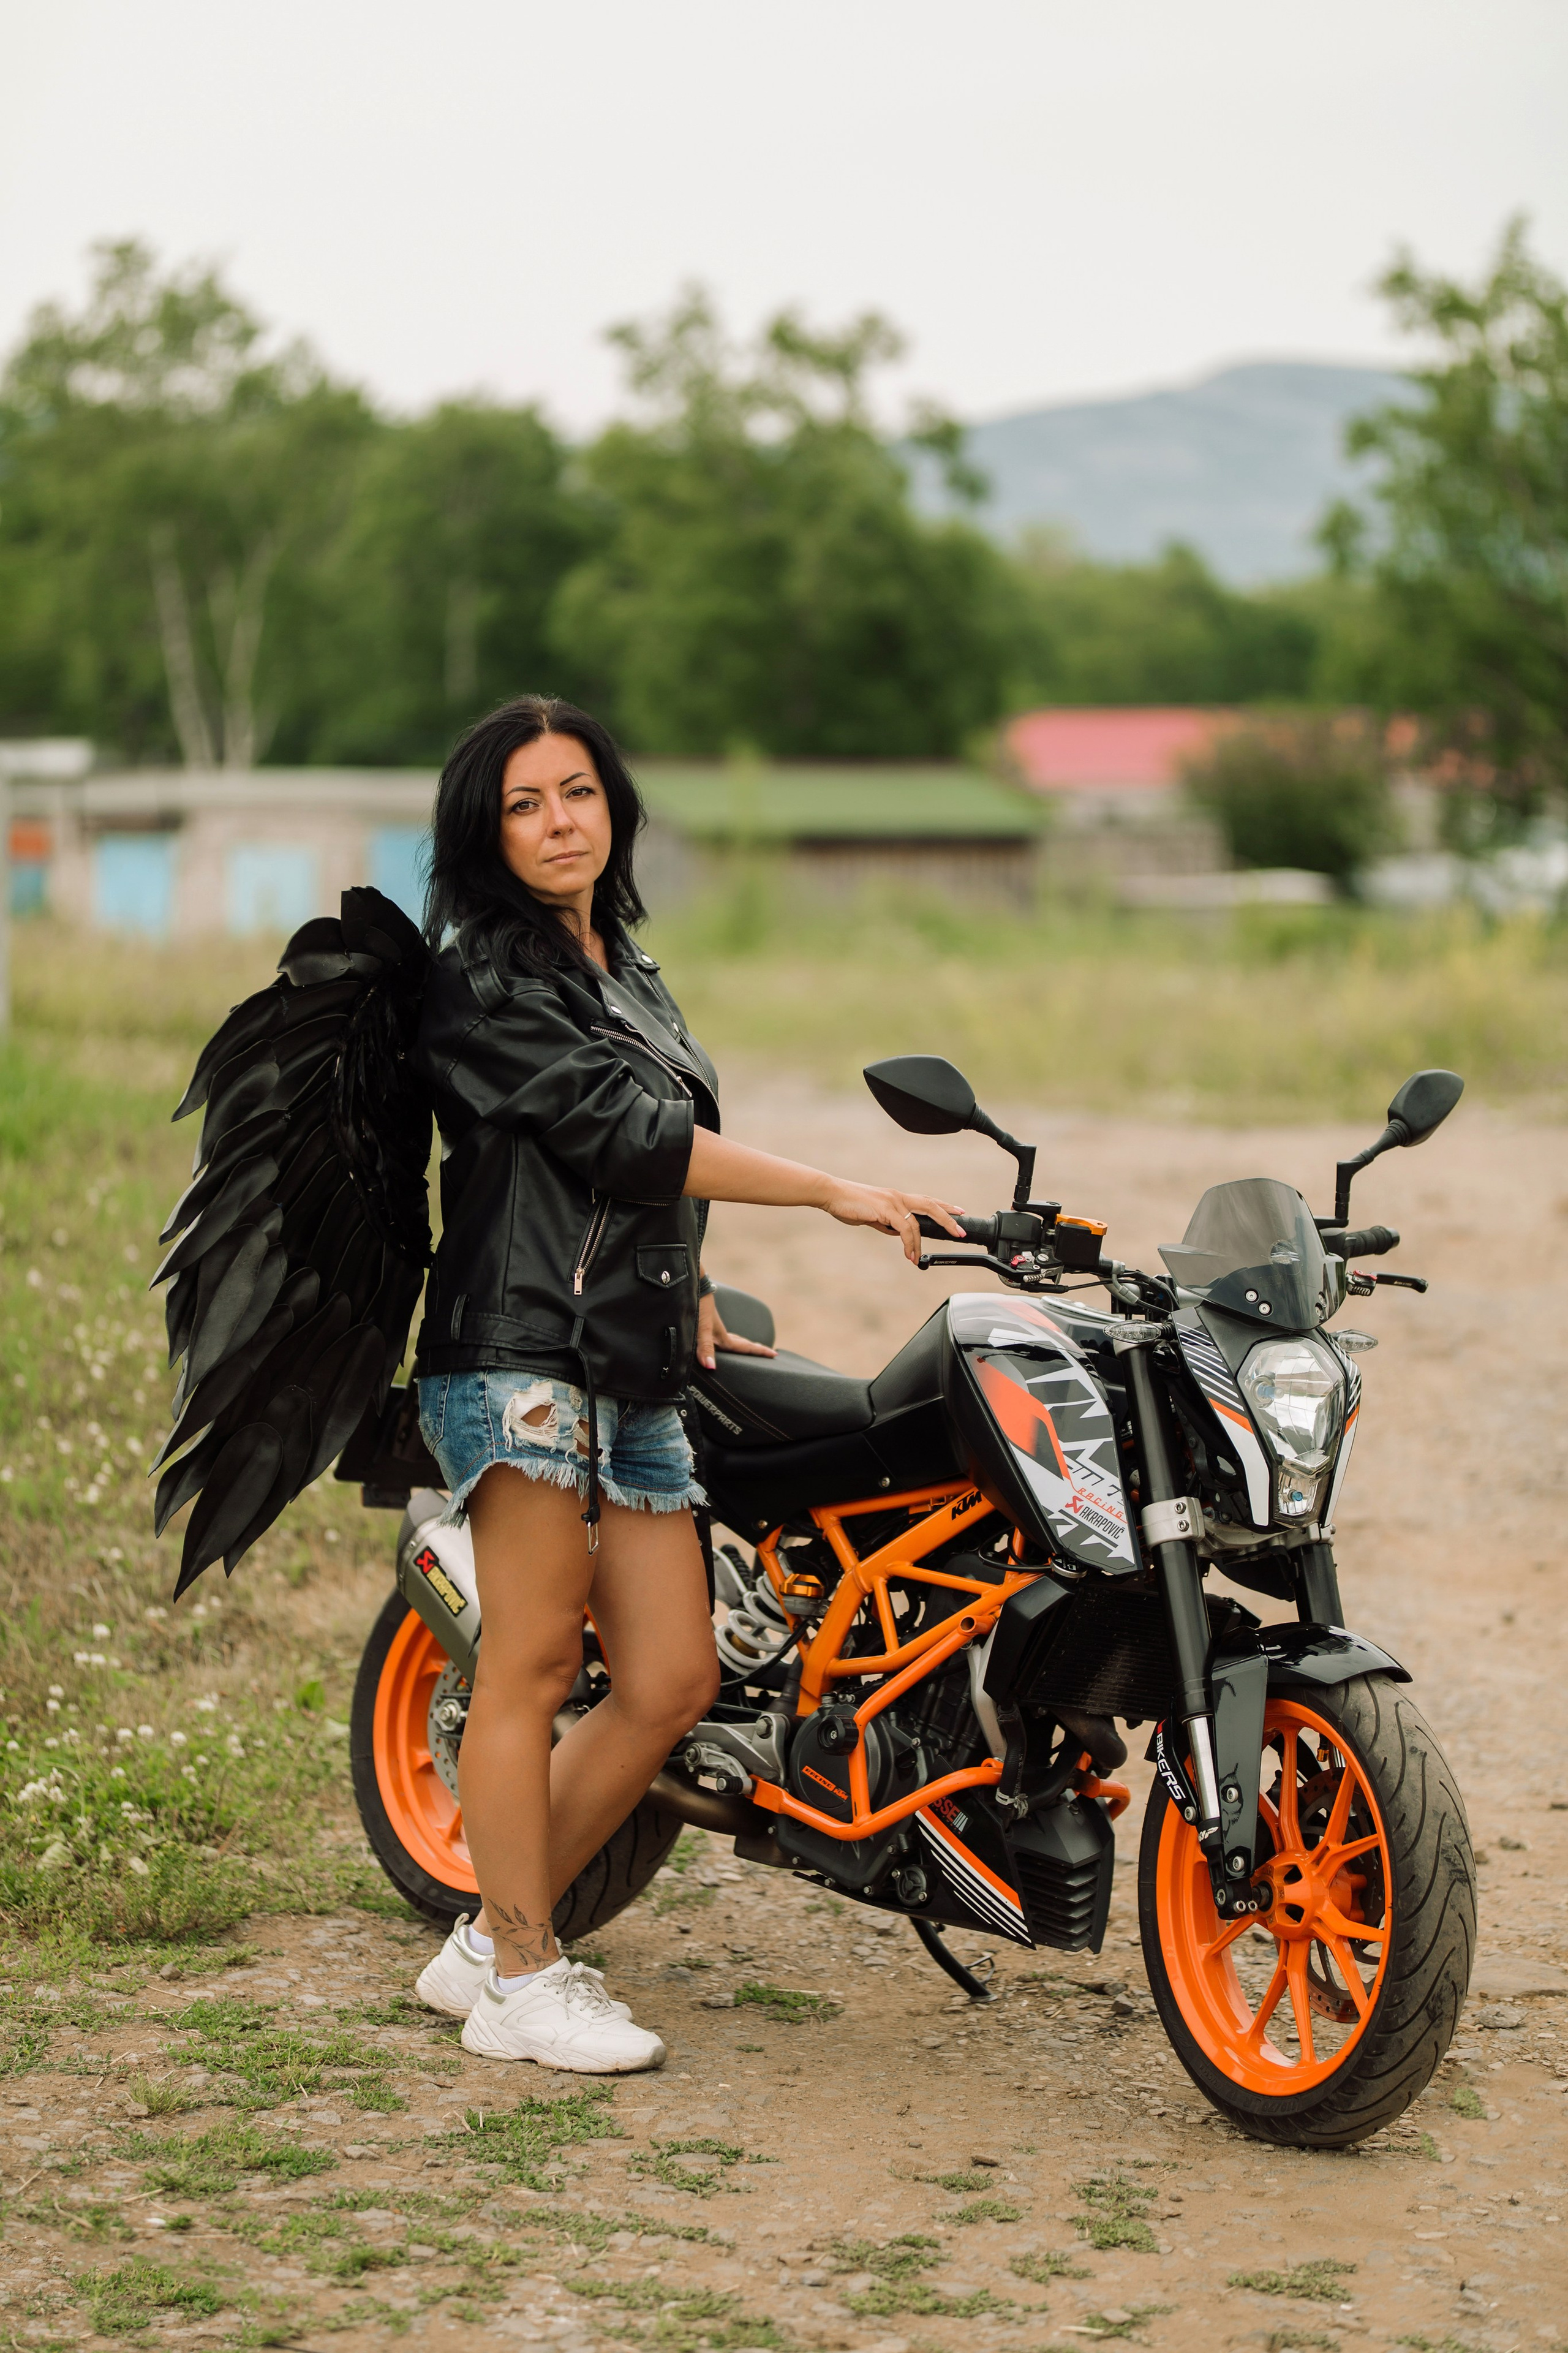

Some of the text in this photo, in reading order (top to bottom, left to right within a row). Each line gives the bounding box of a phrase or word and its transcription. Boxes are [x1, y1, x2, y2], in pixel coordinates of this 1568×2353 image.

[689, 1385, 742, 1435] POWERPARTS
[951, 1491, 982, 1520] KTM
[805, 1768, 832, 1789] RACING
[1156, 1732, 1186, 1800] BIKERS
